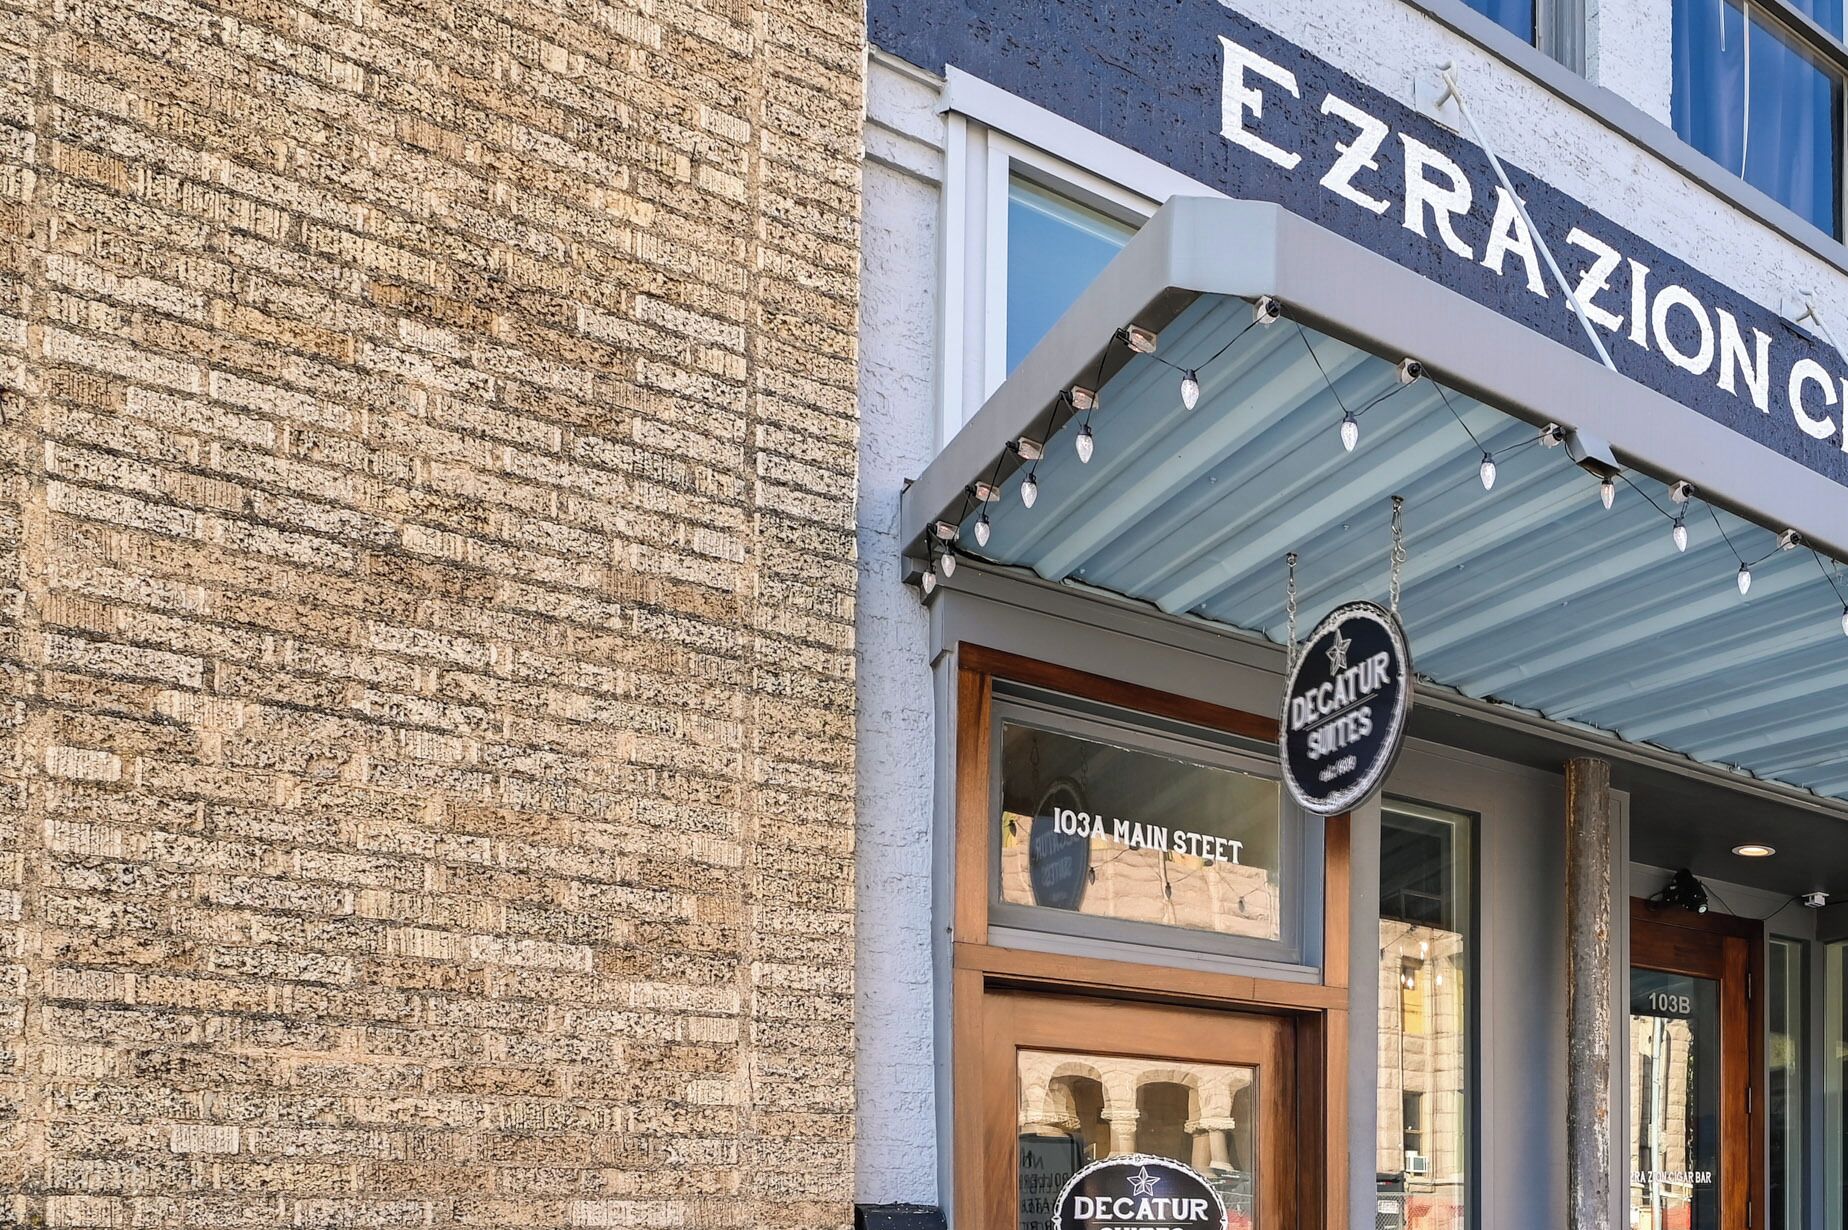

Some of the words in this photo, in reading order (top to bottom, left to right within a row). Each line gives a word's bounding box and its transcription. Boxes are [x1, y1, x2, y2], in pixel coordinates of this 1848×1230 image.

[1218, 36, 1549, 298] EZRA
[1565, 227, 1771, 415] ZION
[1290, 651, 1391, 731] DECATUR
[1306, 706, 1373, 760] SUITES
[1053, 807, 1106, 841] 103A
[1113, 818, 1168, 852] MAIN
[1173, 830, 1244, 865] STEET
[1649, 992, 1690, 1014] 103B
[1648, 1171, 1667, 1182] ZON
[1695, 1171, 1713, 1184] BAR
[1074, 1196, 1208, 1221] DECATUR
